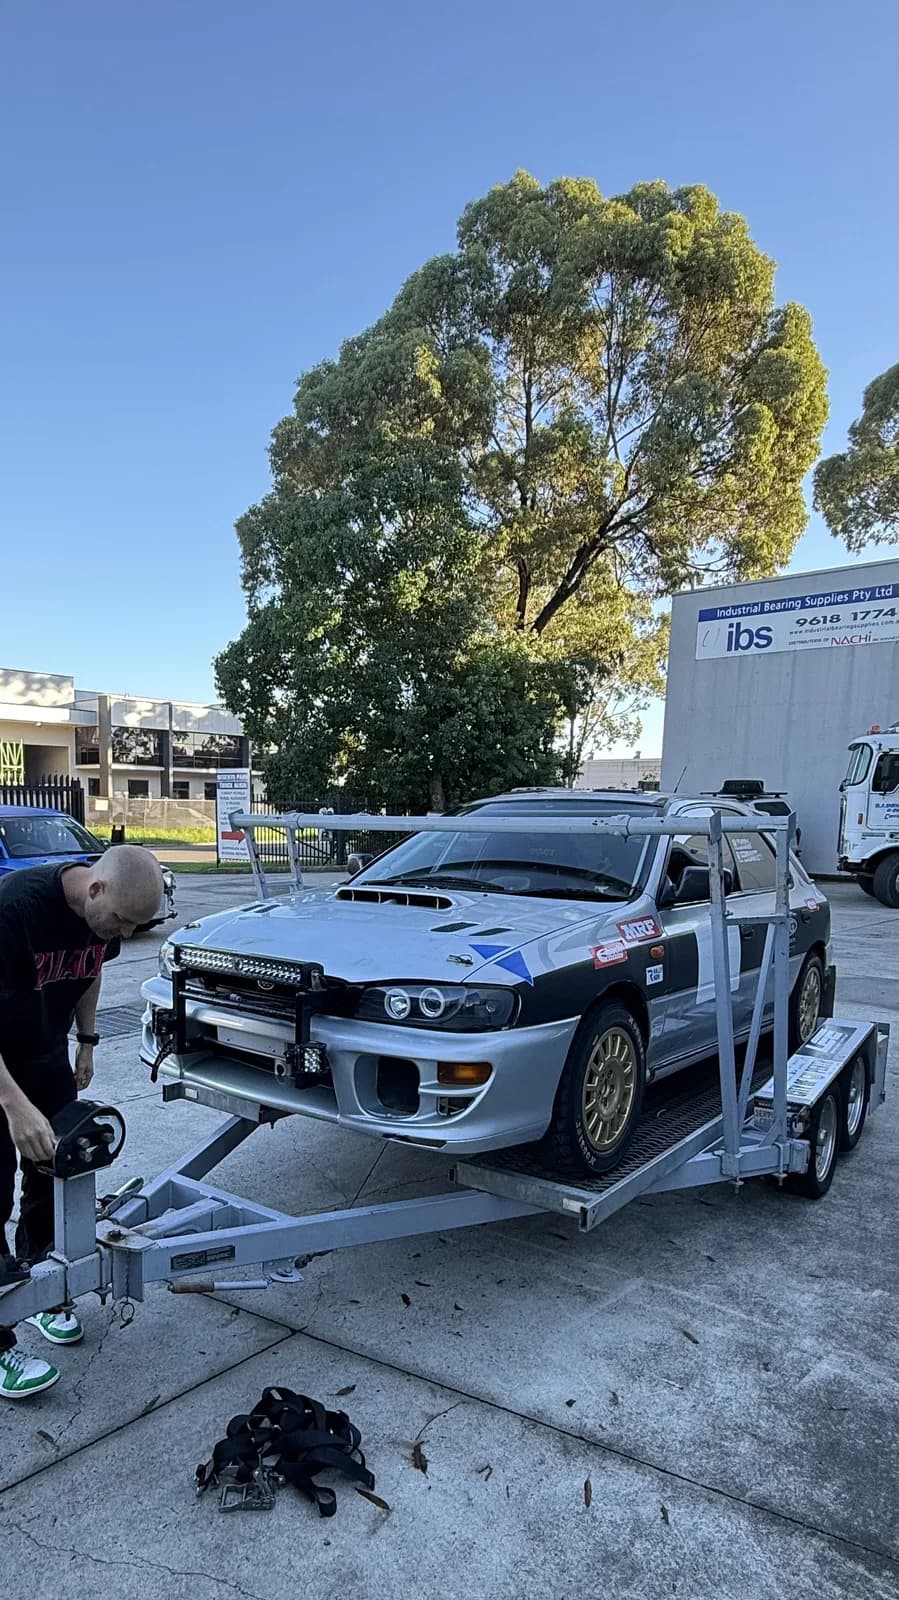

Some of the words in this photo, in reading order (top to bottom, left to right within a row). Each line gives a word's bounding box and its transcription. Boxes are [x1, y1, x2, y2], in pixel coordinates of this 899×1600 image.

[717, 603, 761, 618] Industrial
[764, 599, 801, 612] Bearing
[805, 592, 849, 607] Supplies
[853, 590, 871, 602] Pty
[875, 585, 893, 598] Ltd
[795, 614, 842, 627] 9618
[851, 607, 897, 621] 1774
[726, 622, 773, 652] ibs
[620, 919, 656, 940] MRF
